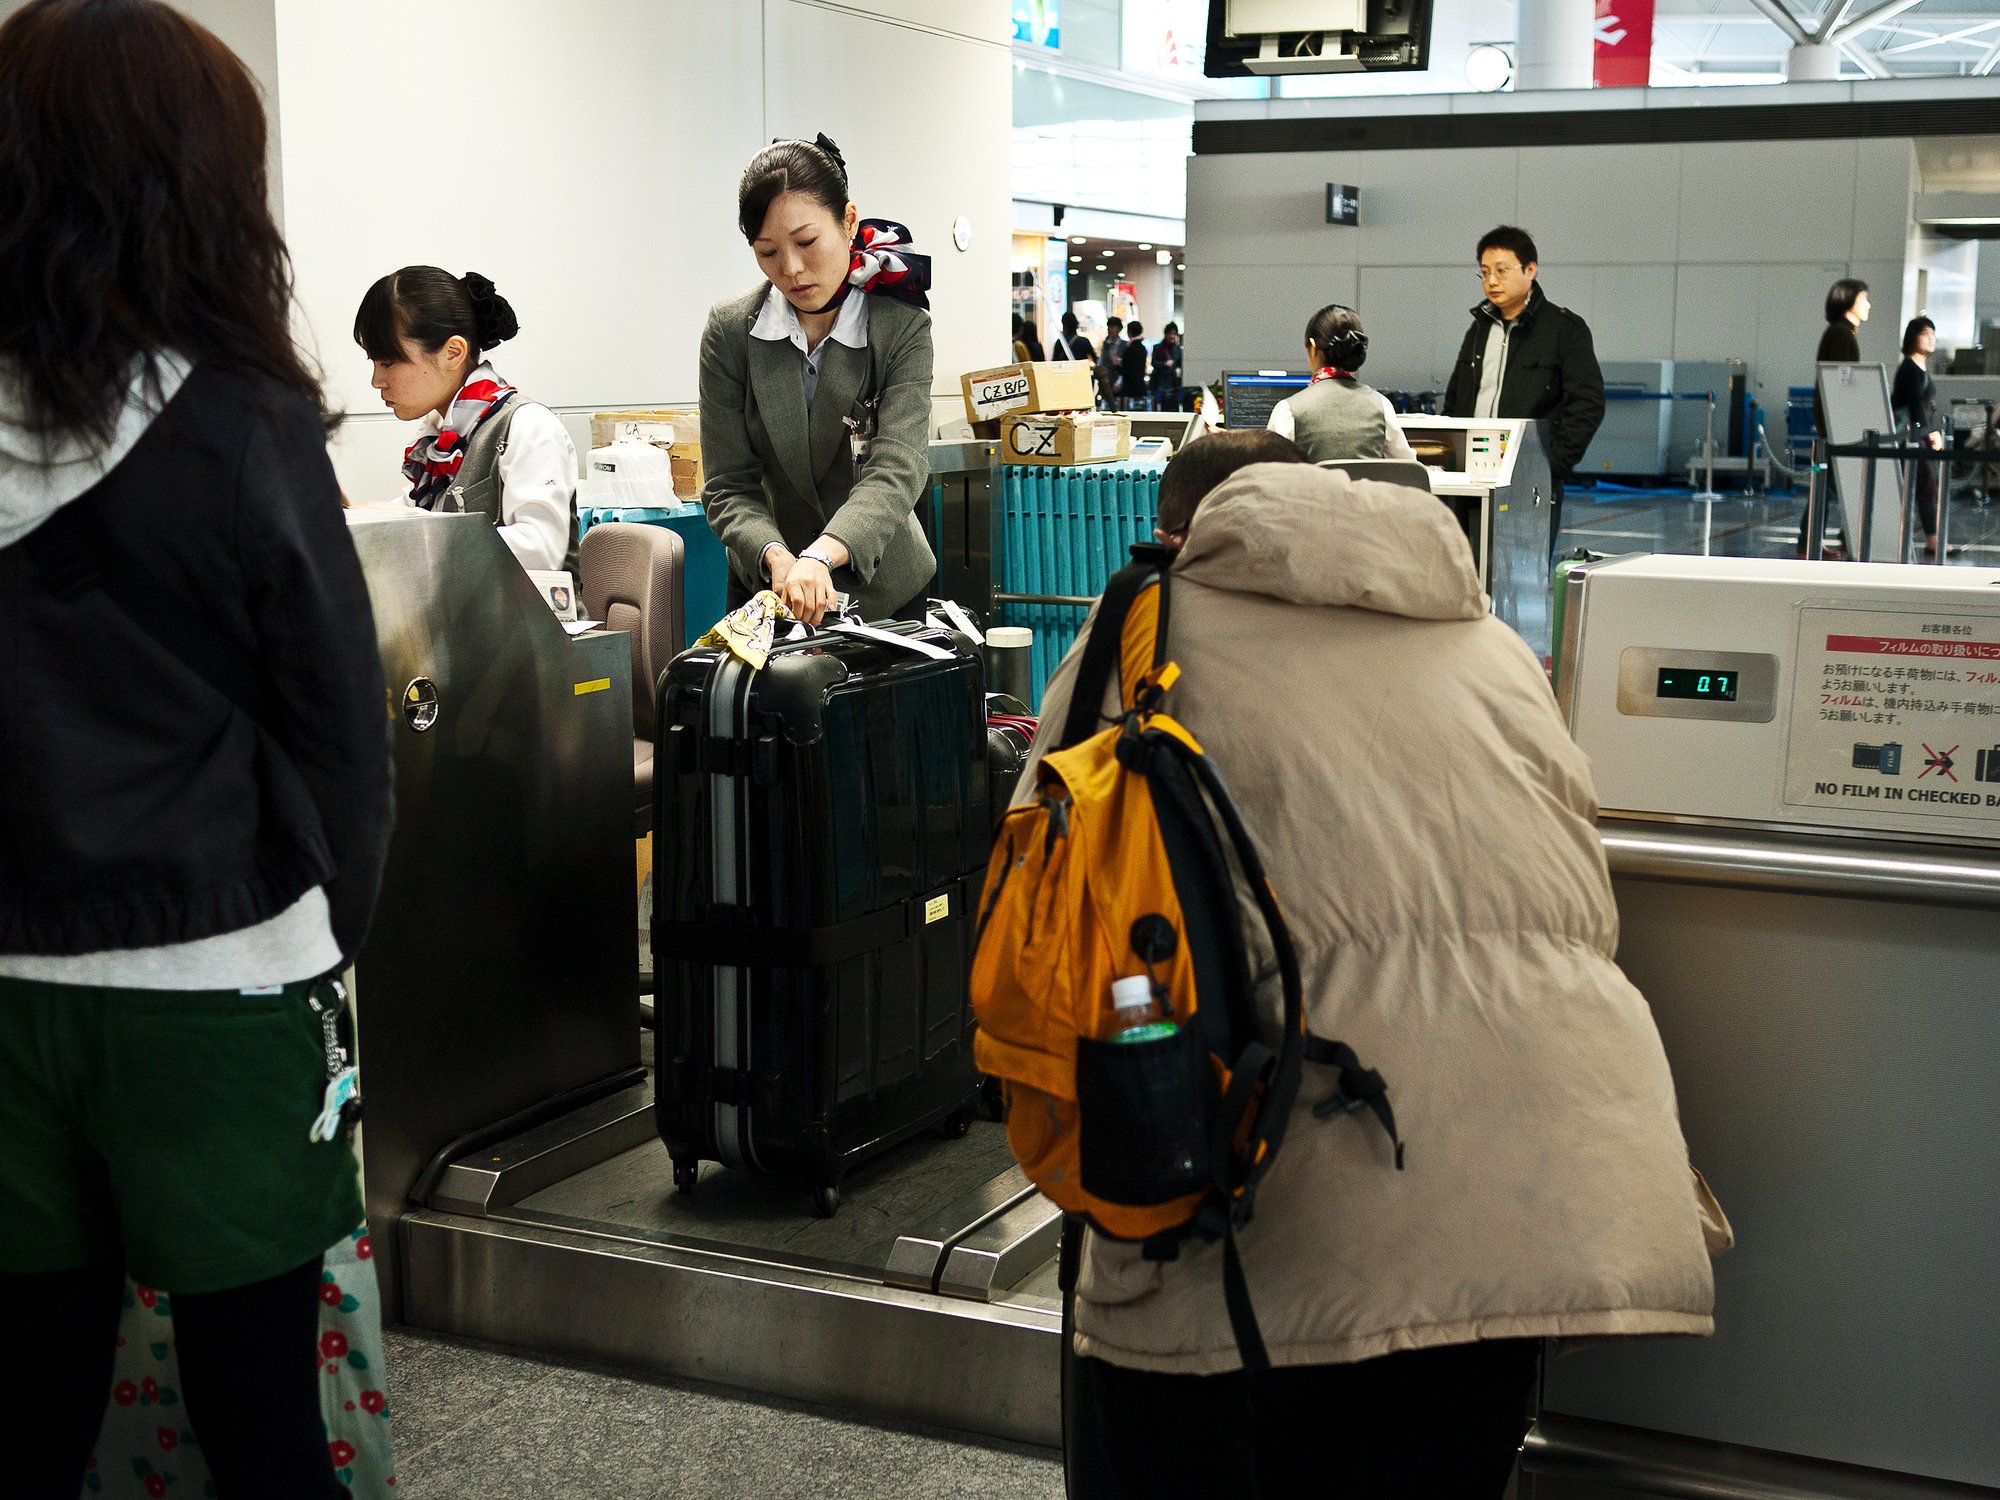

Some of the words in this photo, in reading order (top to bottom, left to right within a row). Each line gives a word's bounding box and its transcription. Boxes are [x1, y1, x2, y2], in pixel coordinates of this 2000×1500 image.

[983, 385, 1002, 402] CZ
[1004, 379, 1027, 395] B/P
[625, 423, 640, 436] CA
[1009, 421, 1062, 457] CZ
[1921, 624, 1972, 636] お客様各位
[1879, 641, 2000, 657] フィルムの取り扱いにつ
[1814, 782, 1838, 796] NO
[1842, 784, 1880, 799] FILM
[1884, 787, 1903, 800] IN
[1907, 788, 1981, 806] CHECKED
